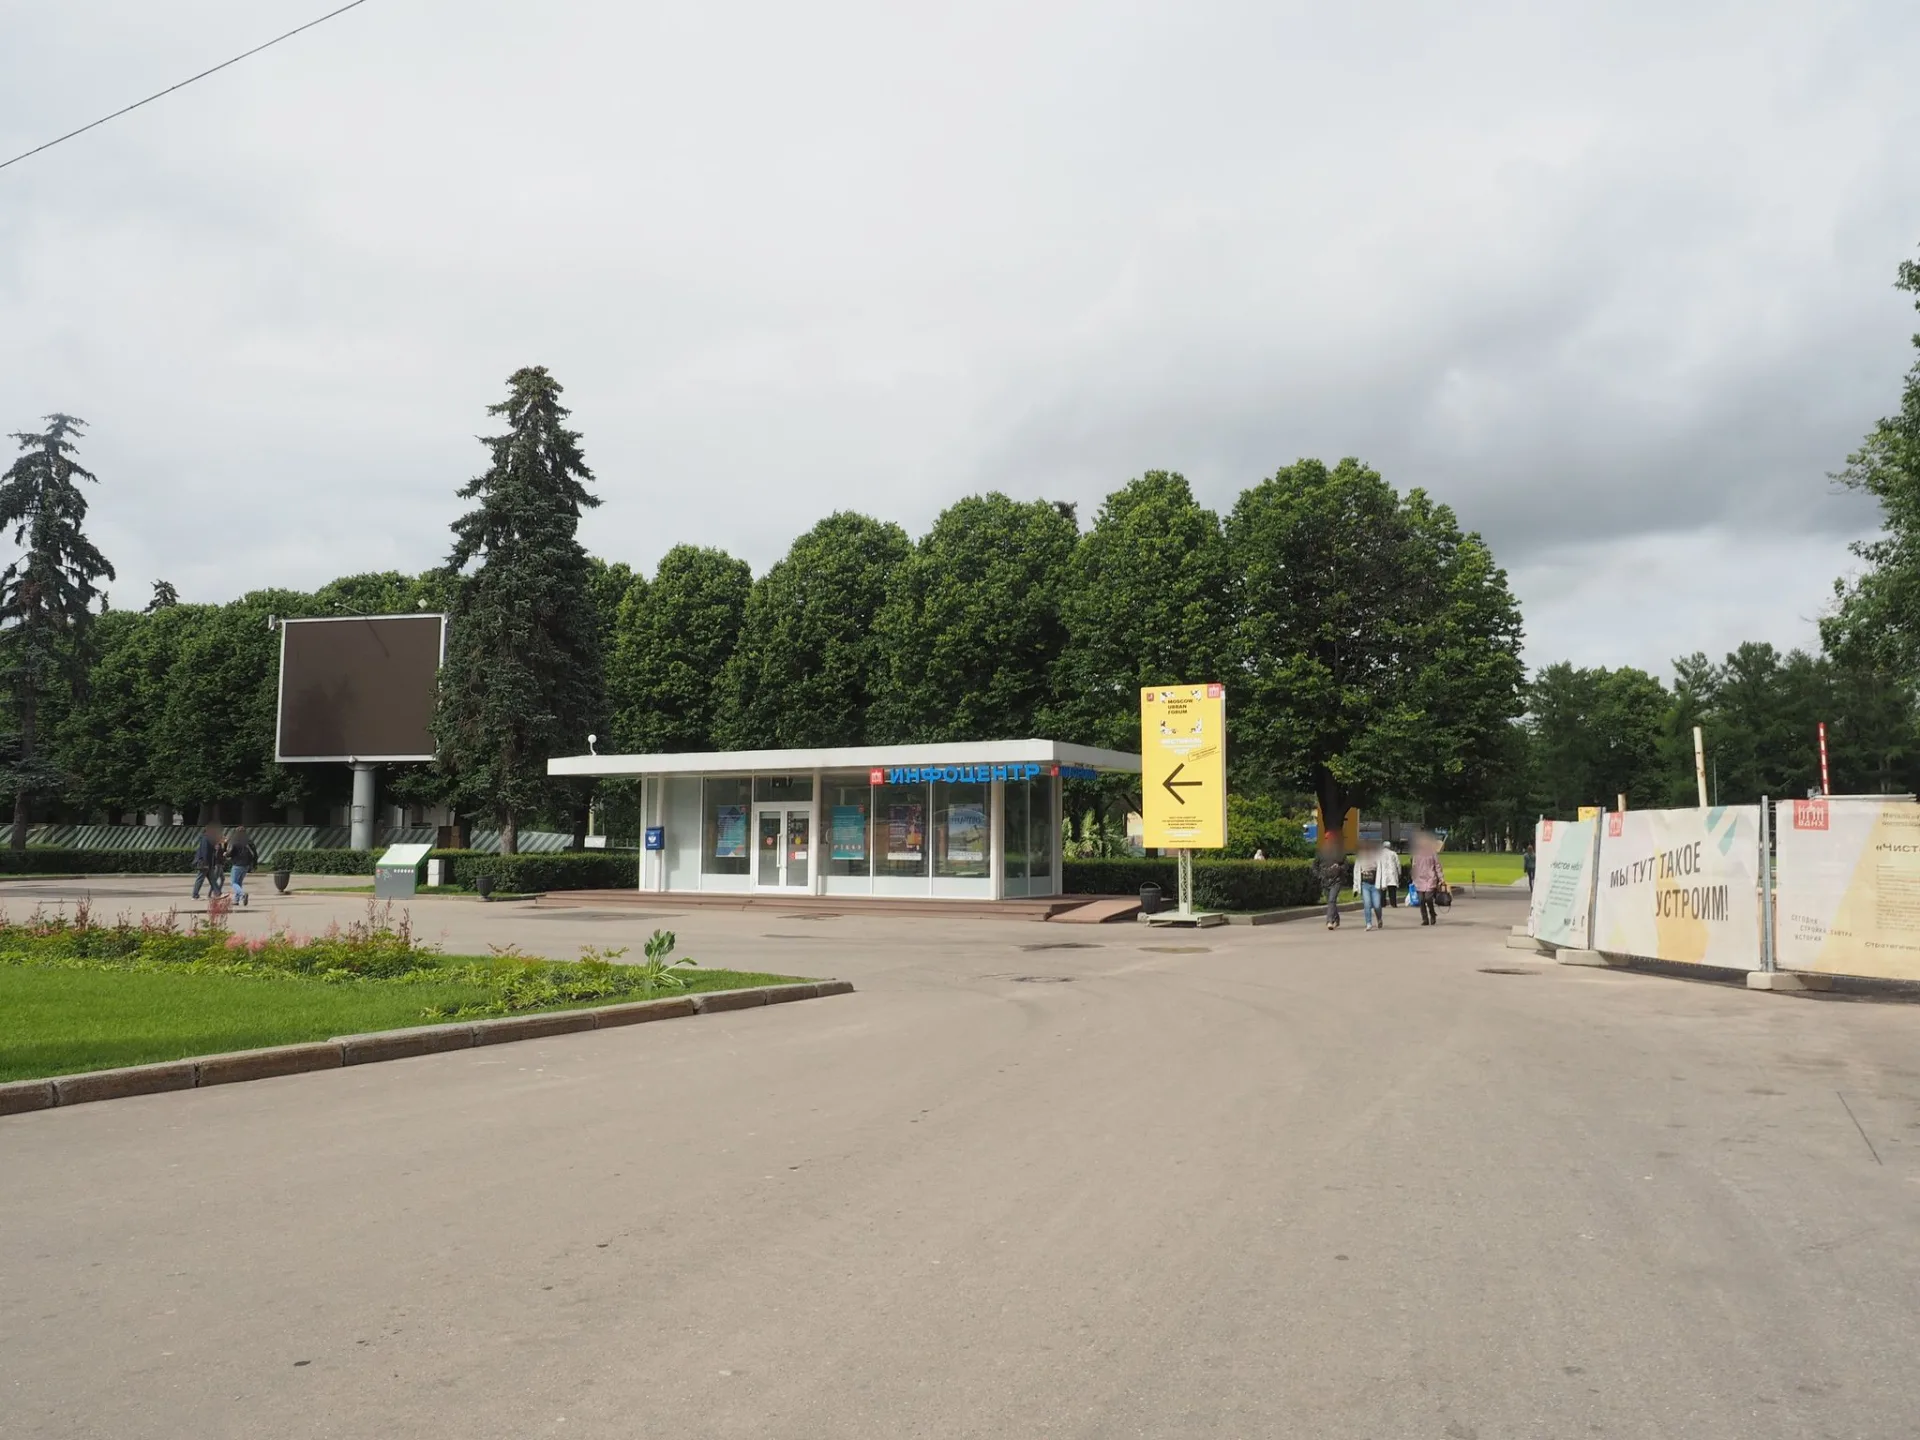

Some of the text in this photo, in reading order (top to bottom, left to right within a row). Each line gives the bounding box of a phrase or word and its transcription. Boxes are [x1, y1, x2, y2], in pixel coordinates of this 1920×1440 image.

[889, 763, 1041, 785] ИНФОЦЕНТР
[1876, 843, 1920, 853] «Чист
[1610, 841, 1702, 888] МЫ ТУТ ТАКОЕ
[1655, 884, 1729, 922] УСТРОИМ!
